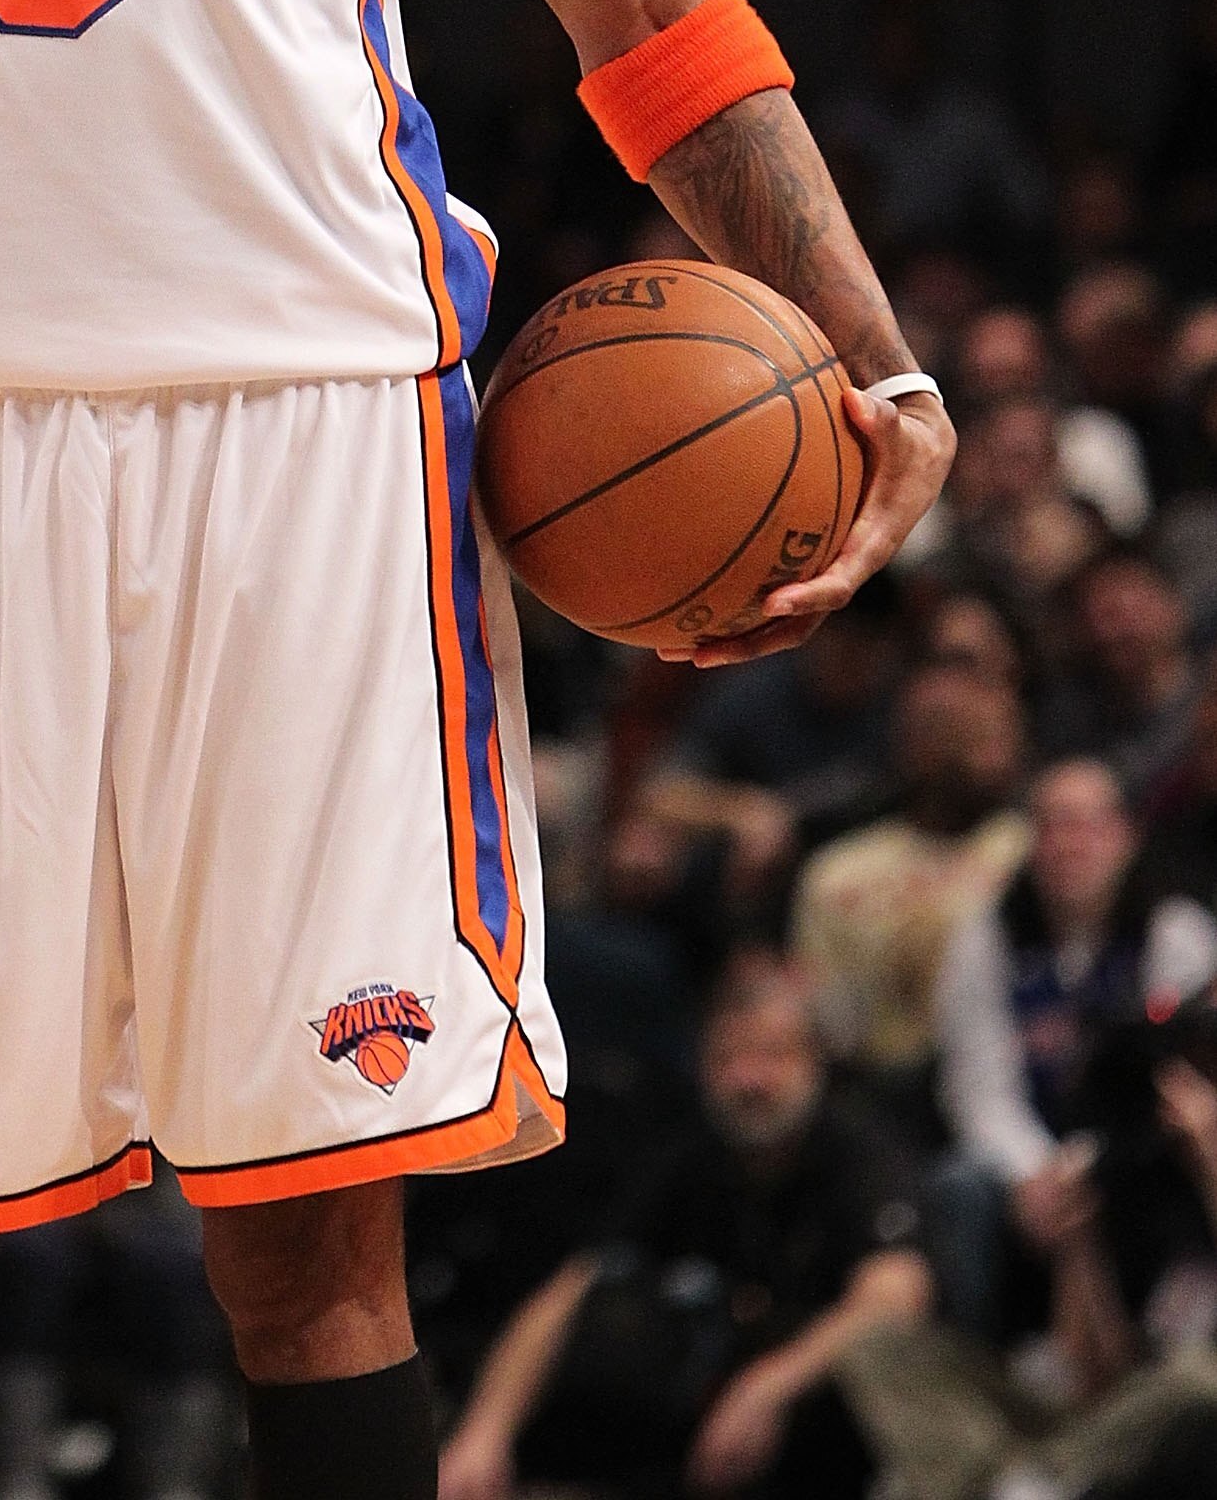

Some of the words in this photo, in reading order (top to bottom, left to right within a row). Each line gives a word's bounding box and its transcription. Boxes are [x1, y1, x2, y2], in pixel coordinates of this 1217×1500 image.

[347, 987, 367, 1003] NEW
[368, 983, 395, 997] YORK
[319, 990, 436, 1060] KNICKS
